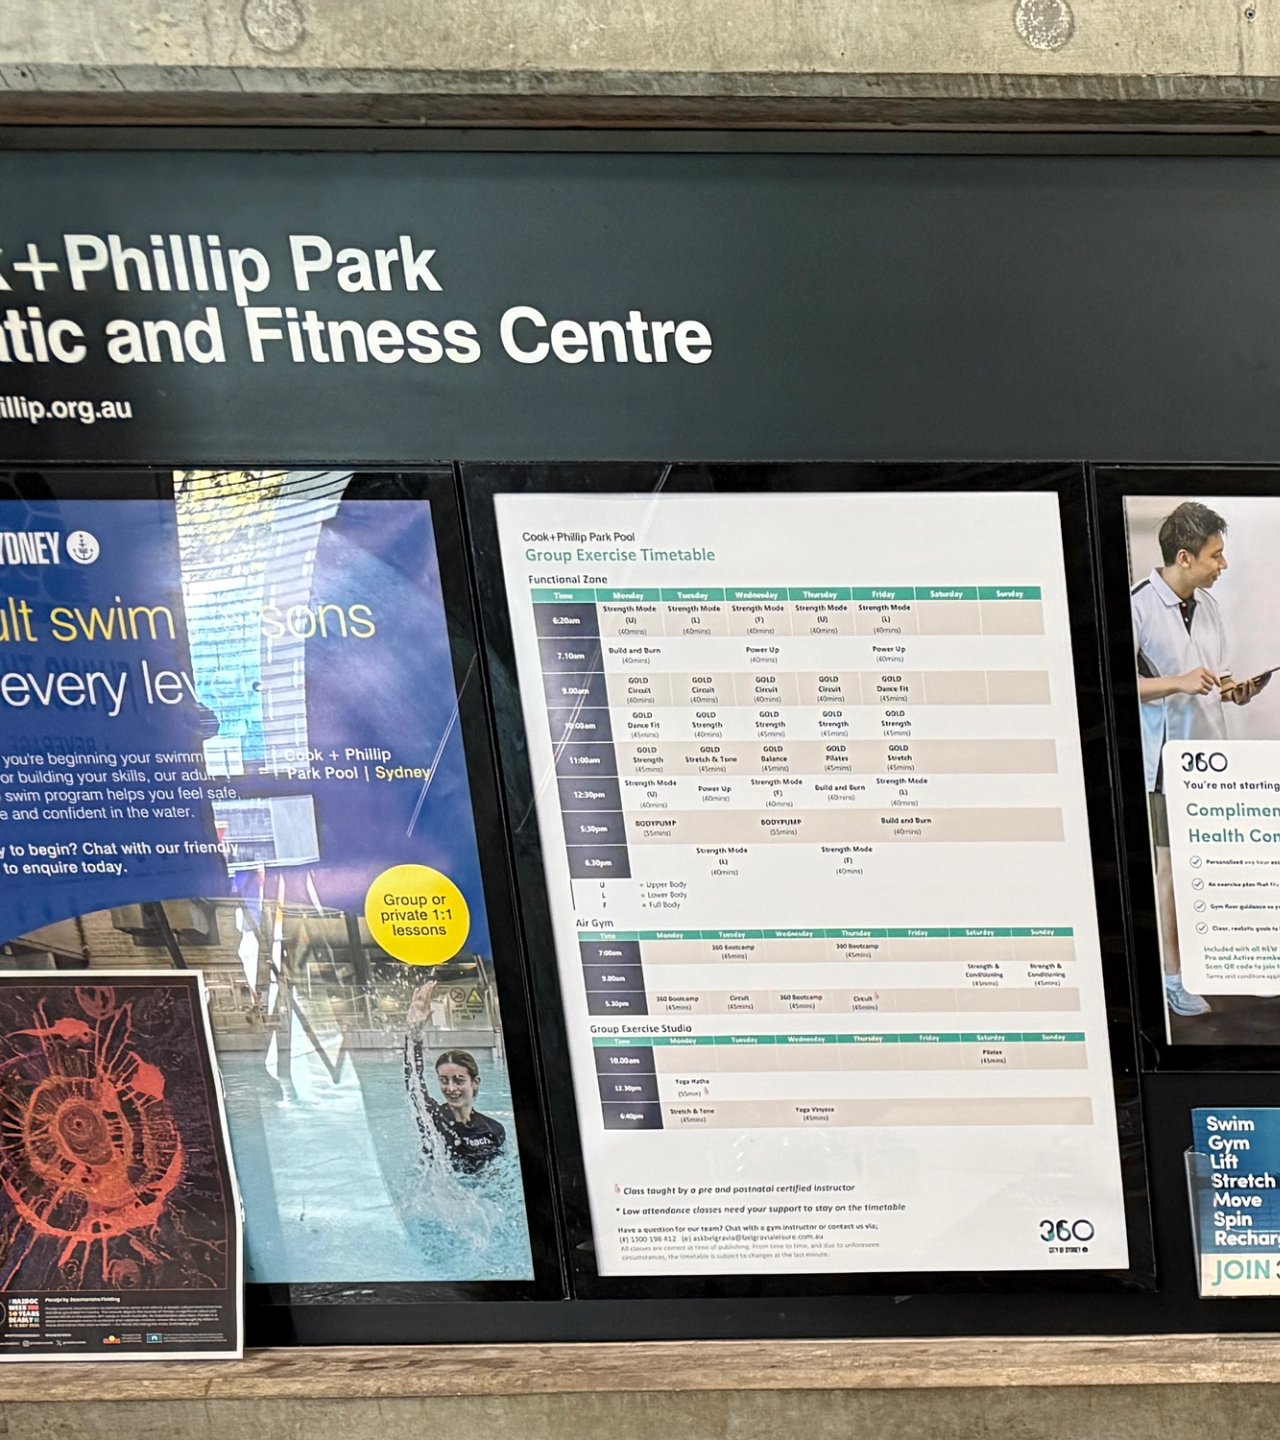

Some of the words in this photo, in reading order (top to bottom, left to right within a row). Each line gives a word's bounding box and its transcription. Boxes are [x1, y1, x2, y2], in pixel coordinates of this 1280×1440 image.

[0, 234, 270, 306] +Phillip
[289, 235, 443, 292] Park
[0, 307, 87, 364] tic
[105, 307, 226, 364] and
[244, 306, 481, 364] Fitness
[500, 306, 712, 364] Centre
[0, 397, 132, 424] illip.org.au
[523, 531, 586, 542] Cook+Phillip
[589, 531, 611, 542] Park
[613, 531, 635, 541] Pool
[525, 548, 572, 563] Group
[576, 548, 636, 562] Exercise
[640, 546, 715, 562] Timetable
[529, 575, 580, 585] Functional
[583, 575, 607, 584] Zone
[51, 596, 176, 642] swim
[0, 671, 128, 716] every
[343, 747, 391, 762] Phillip
[1181, 752, 1227, 772] 360
[287, 765, 317, 780] Park
[325, 765, 358, 780] Pool
[375, 765, 431, 782] Sydney
[1184, 780, 1216, 790] You're
[1218, 781, 1236, 790] not
[1239, 780, 1280, 792] starting
[5, 789, 42, 802] swim
[45, 789, 103, 805] program
[107, 787, 140, 804] helps
[144, 790, 172, 804] you
[177, 786, 203, 801] feel
[208, 786, 241, 802] safe,
[1189, 829, 1245, 843] Health
[4, 863, 22, 876] to
[26, 862, 77, 877] enquire
[83, 862, 127, 877] today.
[384, 894, 429, 911] Group
[433, 897, 446, 906] or
[381, 909, 428, 923] private
[433, 908, 452, 920] 1:1
[392, 924, 446, 936] lessons
[576, 918, 590, 928] Air
[592, 919, 613, 930] Gym
[590, 1024, 618, 1035] Group
[621, 1023, 658, 1033] Exercise
[661, 1023, 692, 1033] Studio
[1207, 1116, 1254, 1131] Swim
[1209, 1136, 1249, 1154] Gym
[1211, 1154, 1238, 1170] Lift
[1212, 1173, 1276, 1188] Stretch
[1213, 1193, 1262, 1208] Move
[1215, 1211, 1252, 1229] Spin
[1040, 1219, 1094, 1242] 360
[1212, 1259, 1270, 1286] JOIN
